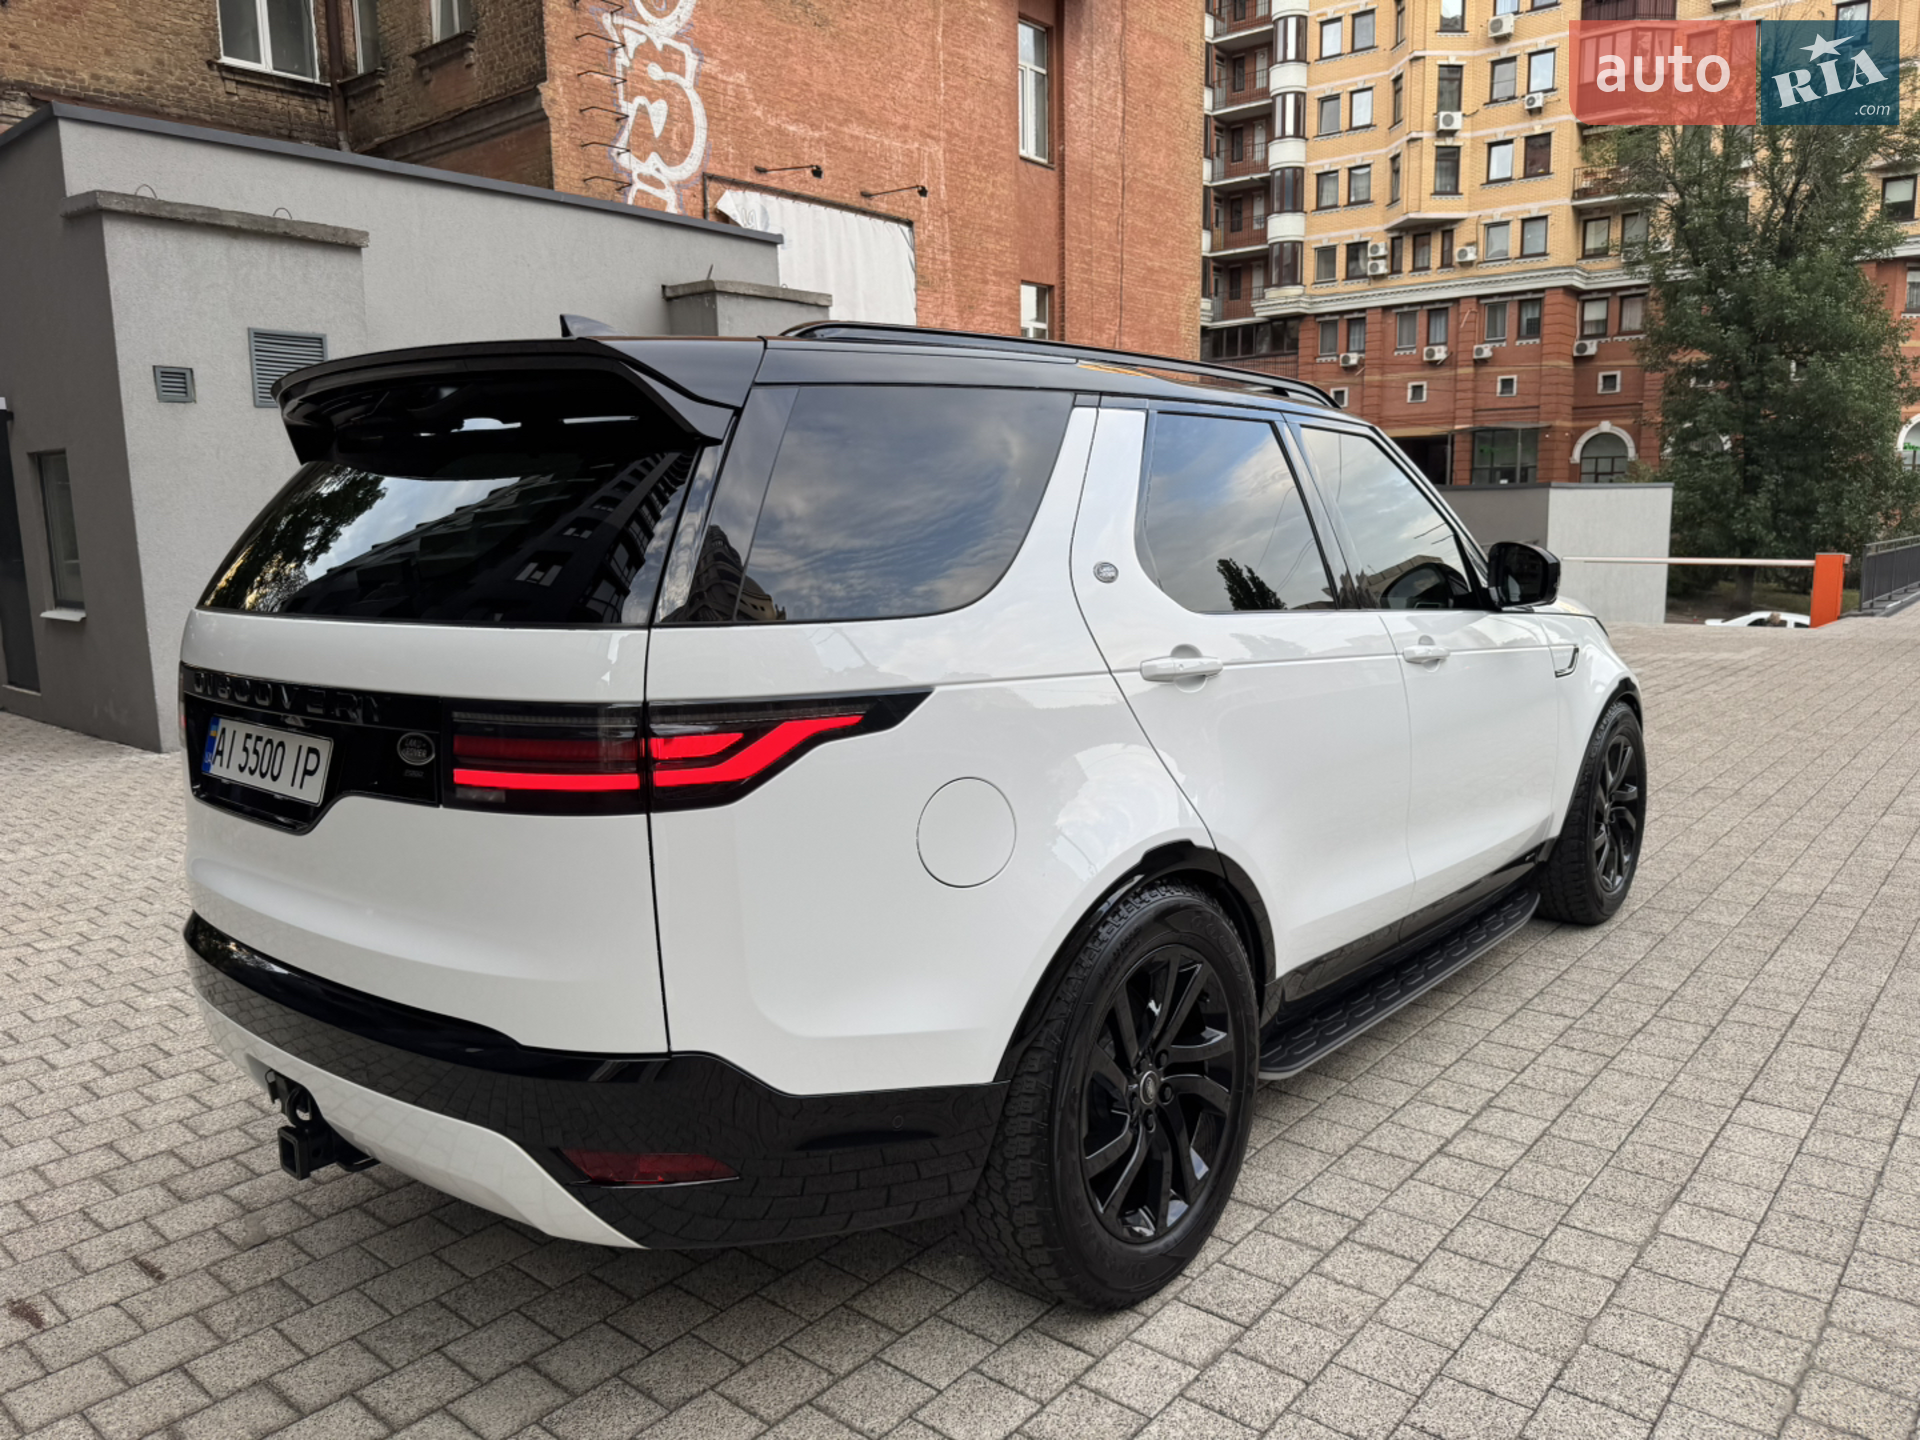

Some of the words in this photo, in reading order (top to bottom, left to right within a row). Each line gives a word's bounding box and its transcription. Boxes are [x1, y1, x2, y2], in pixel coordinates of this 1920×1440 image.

[193, 672, 390, 722] DISCOVERY
[212, 727, 237, 769] AI
[238, 733, 286, 782] 5500
[290, 744, 321, 790] IP
